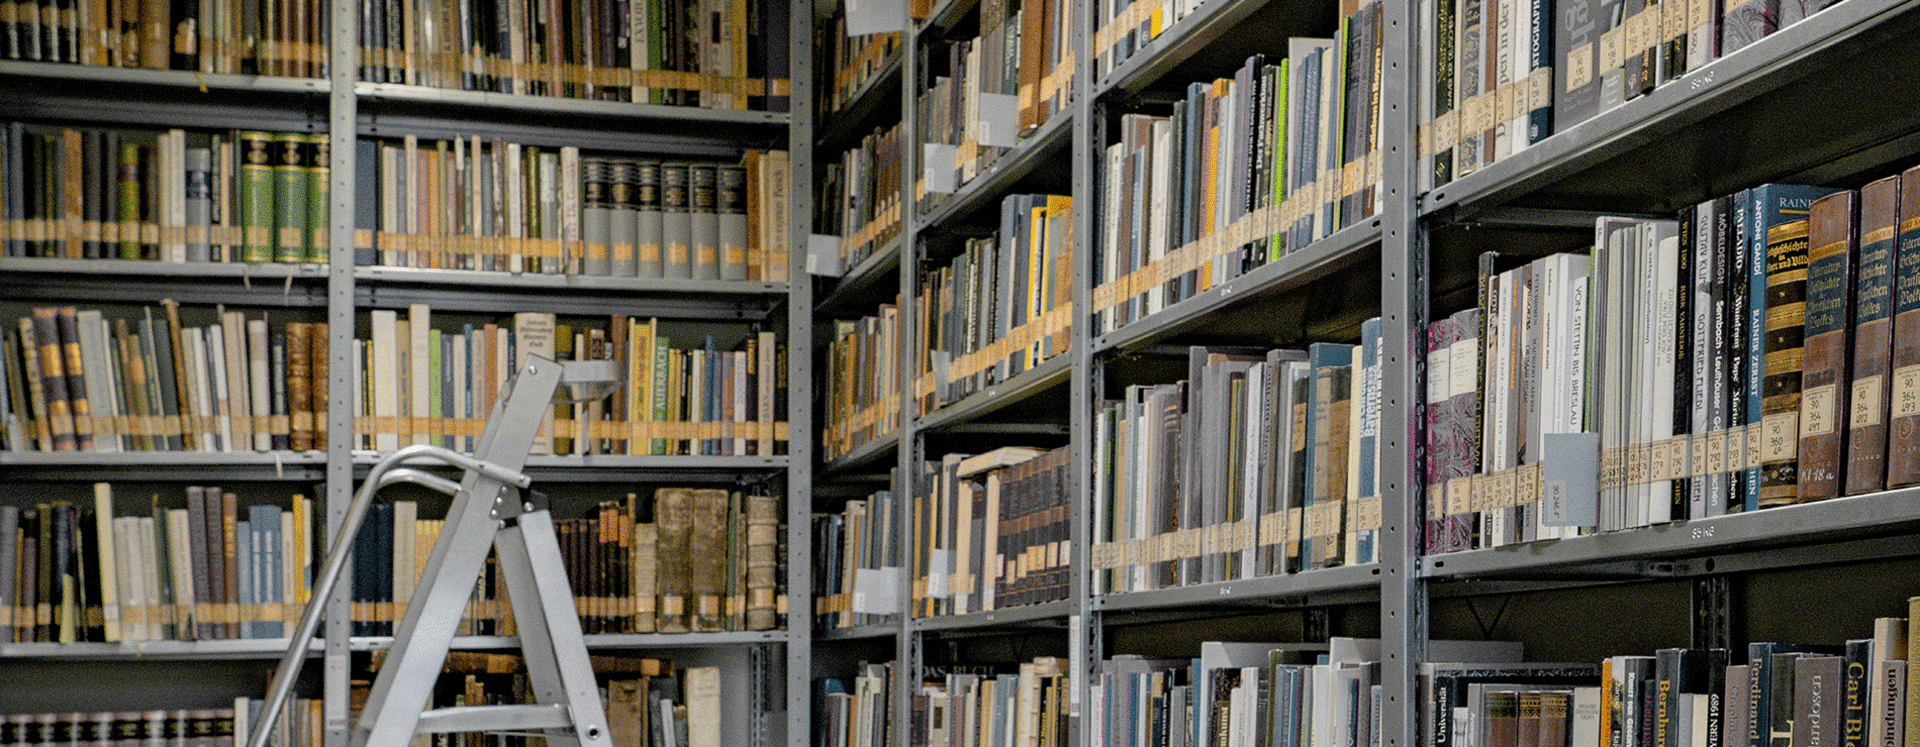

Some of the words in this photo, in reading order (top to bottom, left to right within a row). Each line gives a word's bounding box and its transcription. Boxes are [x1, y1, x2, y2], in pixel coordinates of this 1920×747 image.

[1499, 3, 1510, 30] der
[1499, 39, 1510, 56] in
[1255, 148, 1263, 169] Der
[1699, 214, 1709, 256] GUSTAV
[1735, 208, 1745, 269] PALLADIO
[1754, 200, 1763, 240] ANTONI
[1716, 212, 1727, 285] MÖBELDESIGN
[1753, 242, 1763, 276] GAUDÍ
[1573, 284, 1583, 313] VON
[1679, 284, 1687, 309] KIRK
[1571, 315, 1581, 357] STETTIN
[1696, 313, 1706, 375] GOTTFRIED
[1714, 299, 1724, 348] Sembach
[1752, 309, 1760, 352] RAINER
[655, 346, 668, 410] AUERBACH
[1571, 359, 1580, 377] BIS
[1750, 354, 1759, 397] ZERBST
[1364, 385, 1376, 437] Bayerns
[1569, 379, 1579, 426] BRESLAU
[1710, 693, 1719, 717] 1989
[1750, 657, 1763, 740] Ferdinand
[1847, 661, 1865, 711] Carl
[1437, 686, 1447, 744] Universität
